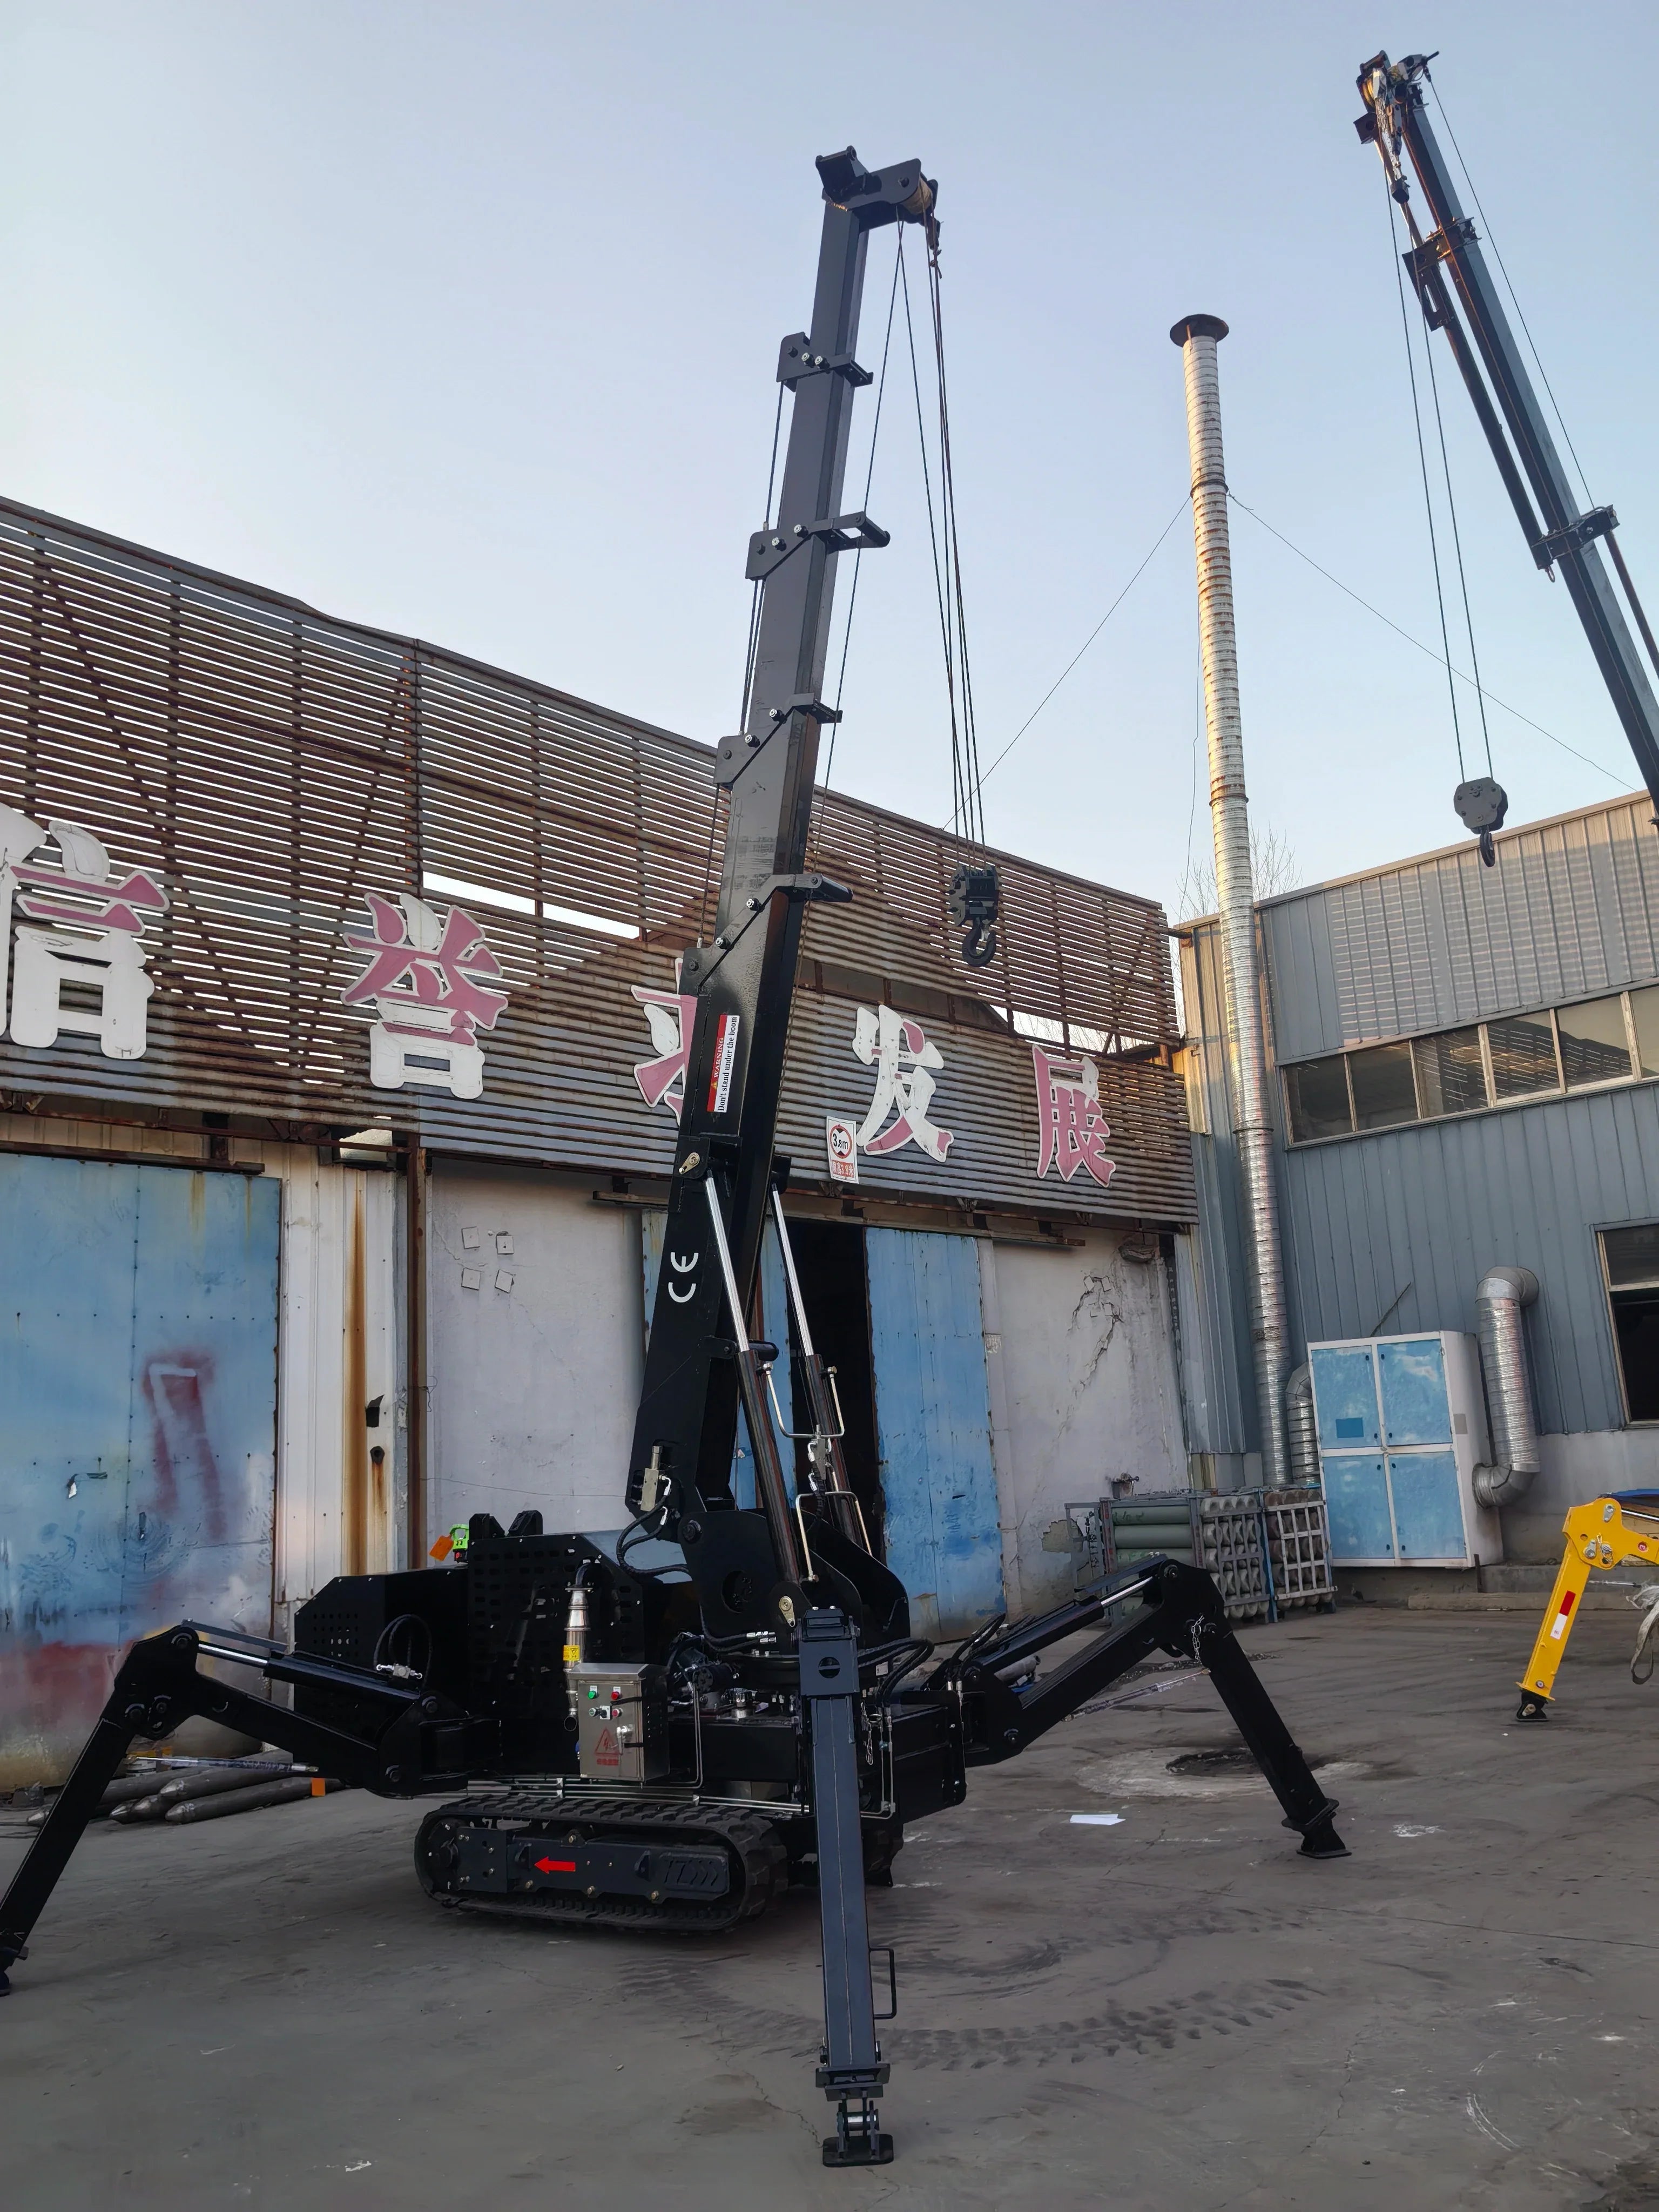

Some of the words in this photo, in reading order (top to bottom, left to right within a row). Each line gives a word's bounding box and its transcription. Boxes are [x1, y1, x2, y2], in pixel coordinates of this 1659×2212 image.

[713, 1037, 724, 1078] WARNING
[717, 1094, 727, 1111] Don't
[729, 1017, 737, 1035] boom
[833, 1133, 848, 1150] 3.8m
[668, 1252, 699, 1303] CE
